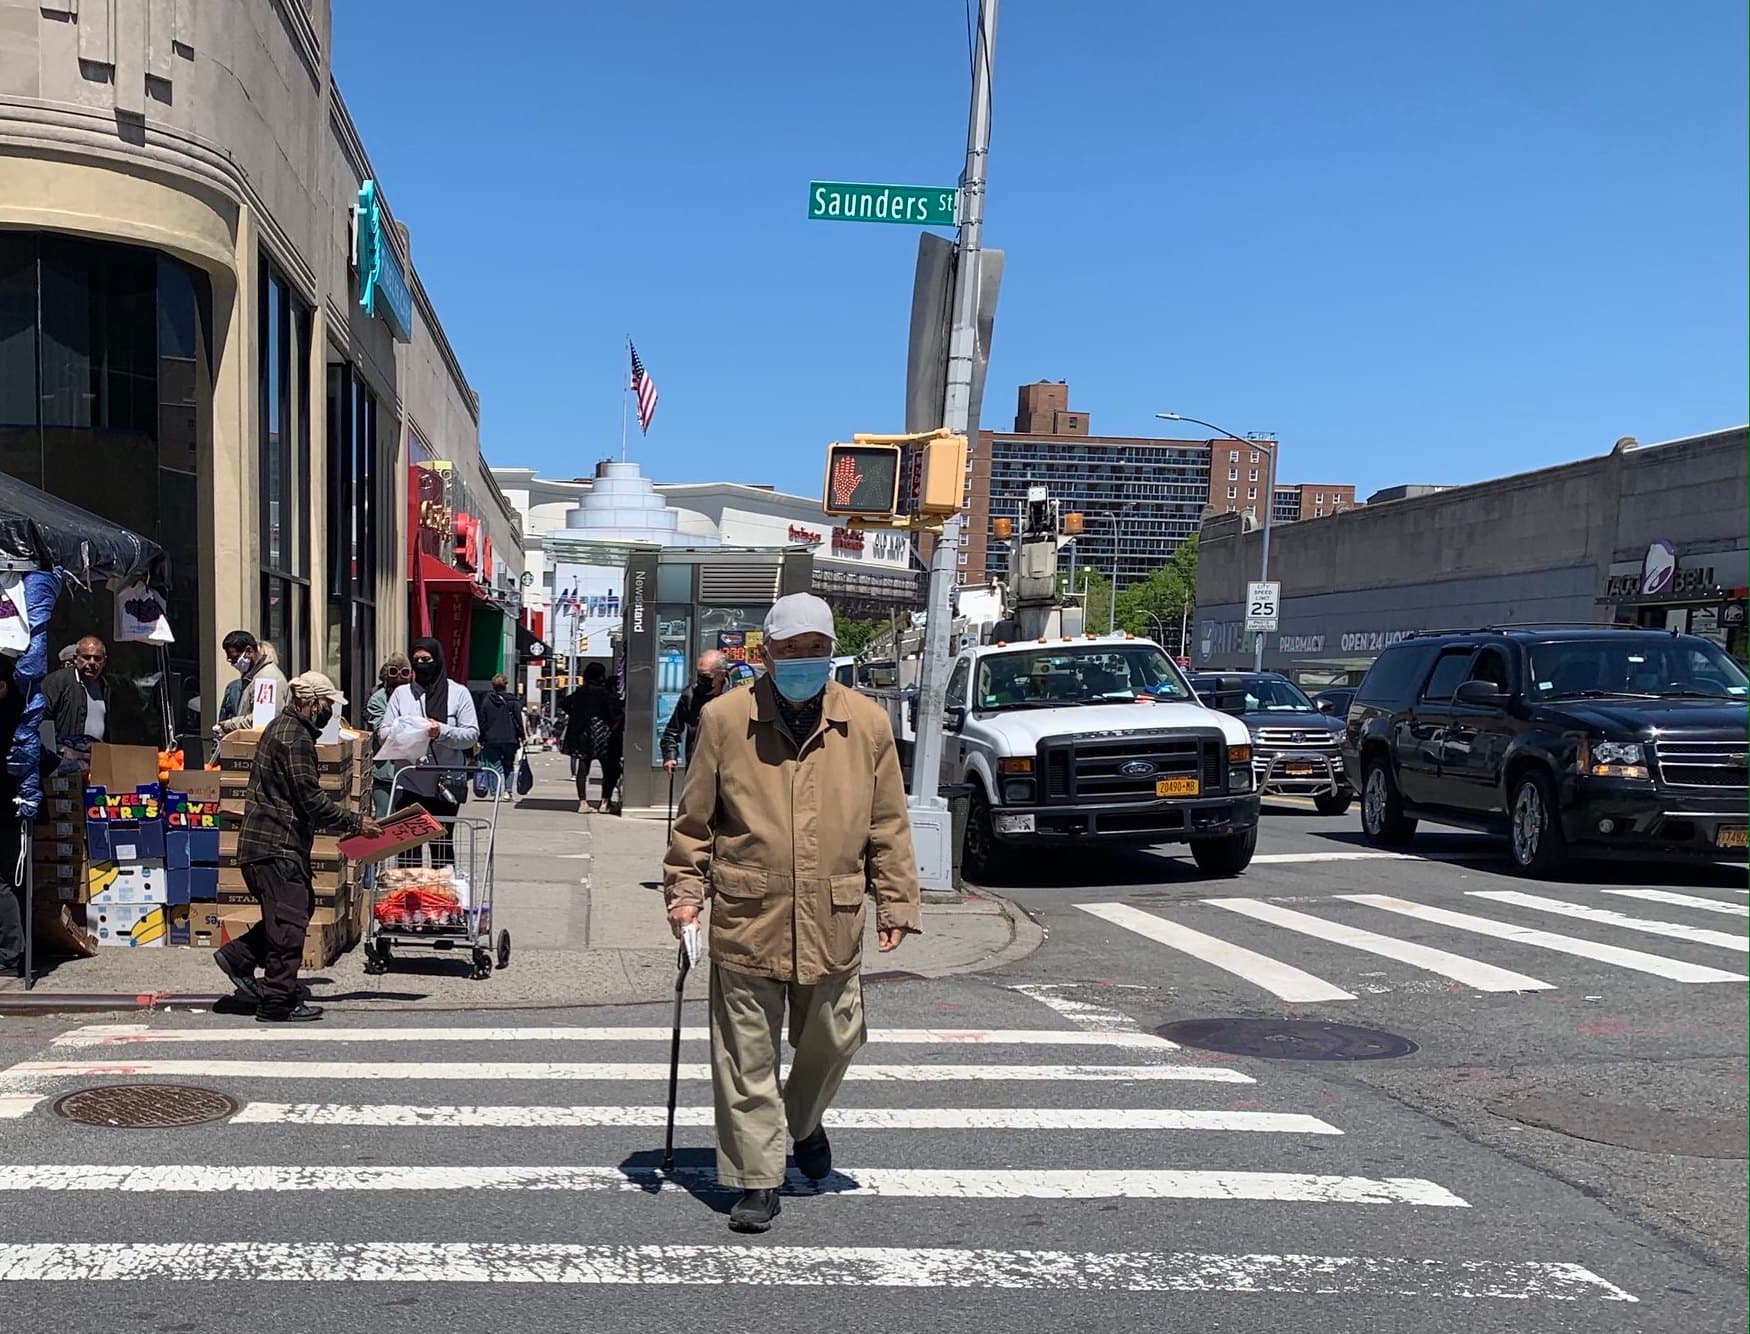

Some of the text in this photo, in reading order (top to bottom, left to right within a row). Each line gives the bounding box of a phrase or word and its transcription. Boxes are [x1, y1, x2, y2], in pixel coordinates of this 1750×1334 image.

[814, 187, 953, 220] Saunders St
[1251, 602, 1274, 616] 25
[1279, 635, 1325, 652] PHARMACY
[1341, 633, 1368, 651] OPEN
[1369, 632, 1382, 650] 24
[95, 793, 151, 807] SWEET
[87, 806, 158, 819] CITRUS
